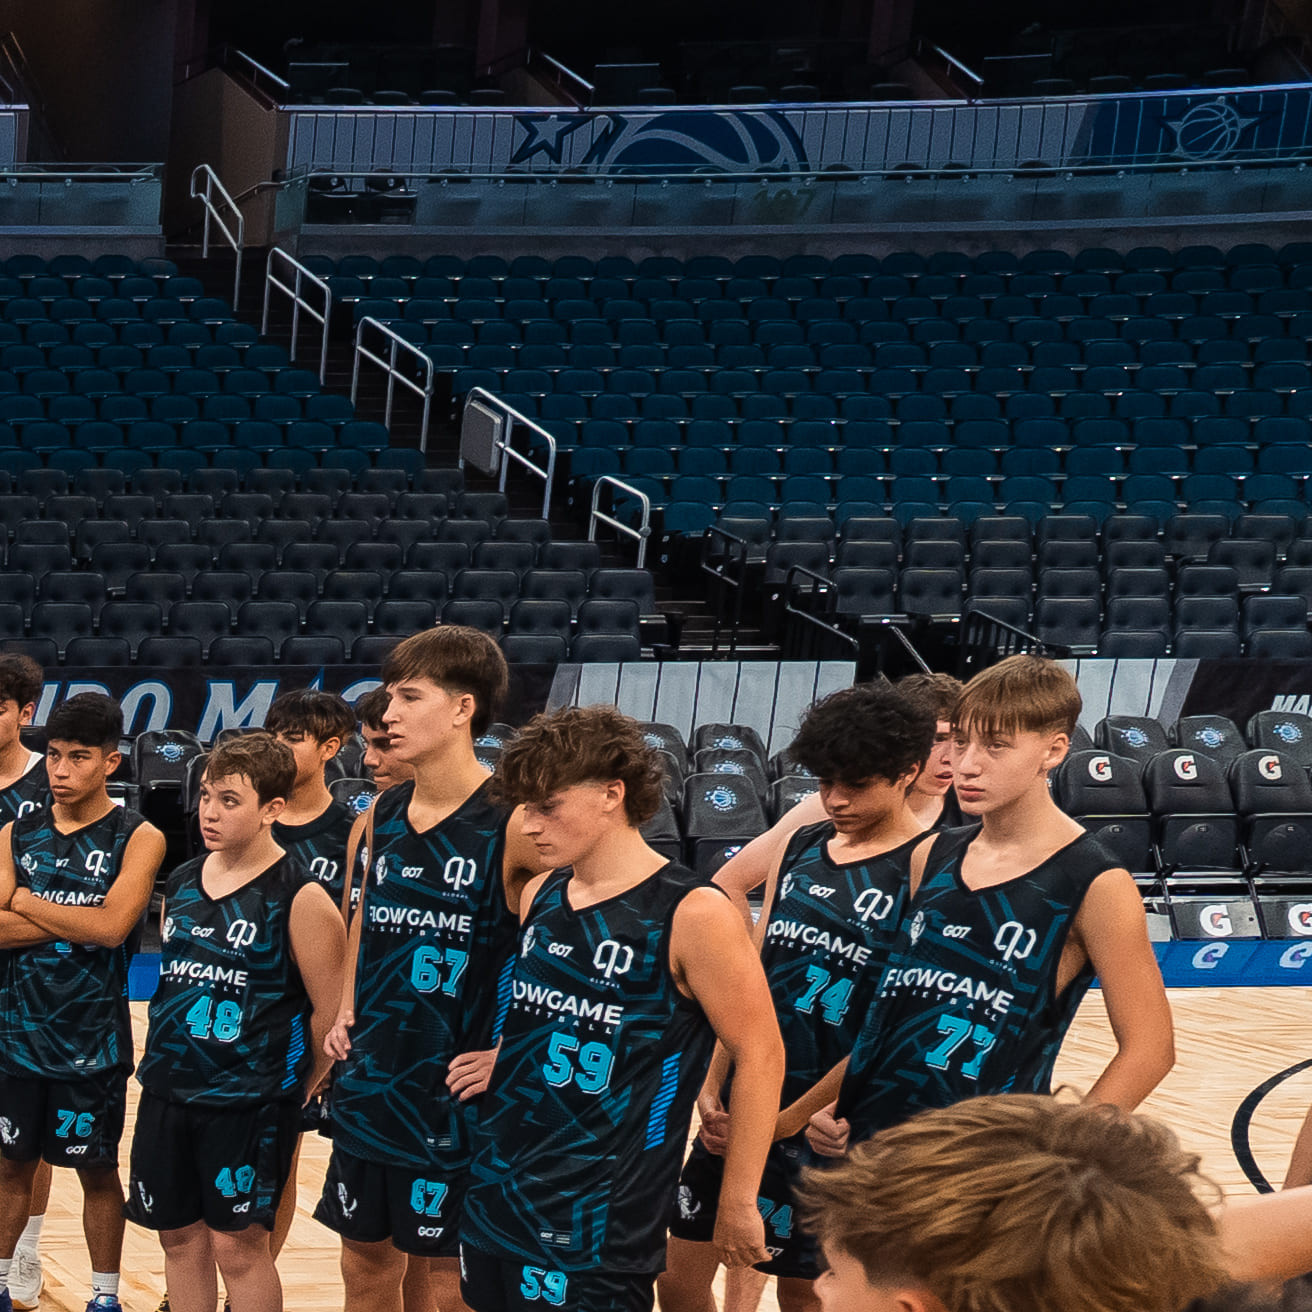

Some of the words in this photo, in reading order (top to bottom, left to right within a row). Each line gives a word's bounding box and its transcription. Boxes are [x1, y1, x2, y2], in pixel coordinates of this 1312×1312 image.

[1088, 756, 1113, 781] G
[1173, 755, 1198, 780] G
[1258, 755, 1283, 780] G
[1199, 905, 1233, 937] G
[767, 919, 873, 966] OWGAME
[160, 959, 249, 988] LWGAME
[410, 945, 470, 998] 67
[512, 979, 625, 1025] OWGAME
[793, 964, 856, 1026] 74
[542, 1031, 616, 1095] 59
[924, 1013, 998, 1081] 77
[55, 1109, 96, 1139] 76
[409, 1178, 449, 1218] 67
[765, 1246, 784, 1257] O7
[519, 1265, 569, 1306] 59
